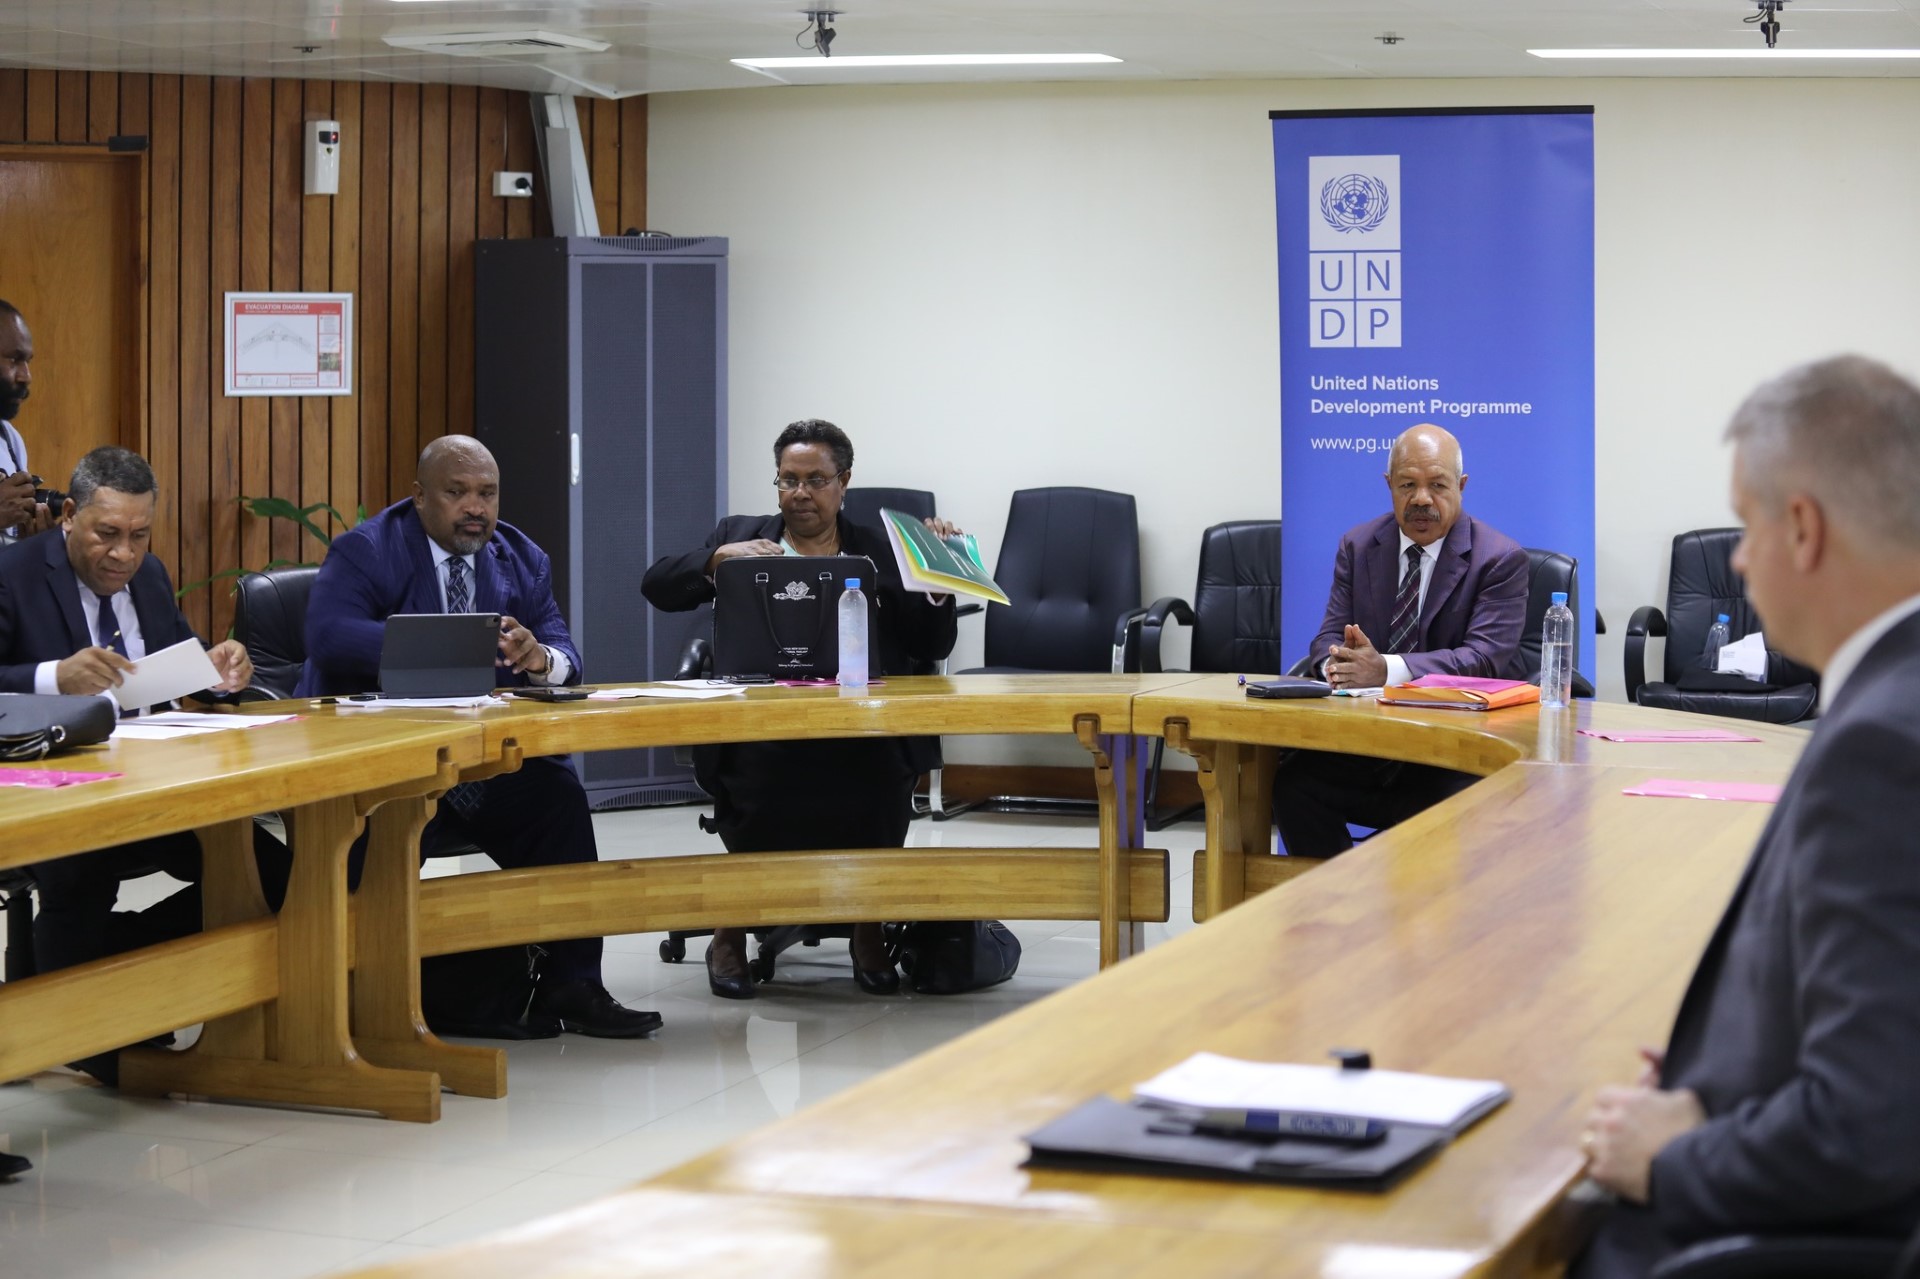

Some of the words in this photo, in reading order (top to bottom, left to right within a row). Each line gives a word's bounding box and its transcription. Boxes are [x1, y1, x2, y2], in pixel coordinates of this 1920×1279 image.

[1311, 375, 1367, 391] United
[1372, 375, 1439, 391] Nations
[1311, 399, 1426, 417] Development
[1430, 399, 1532, 418] Programme
[1310, 437, 1396, 453] www.pg.u
